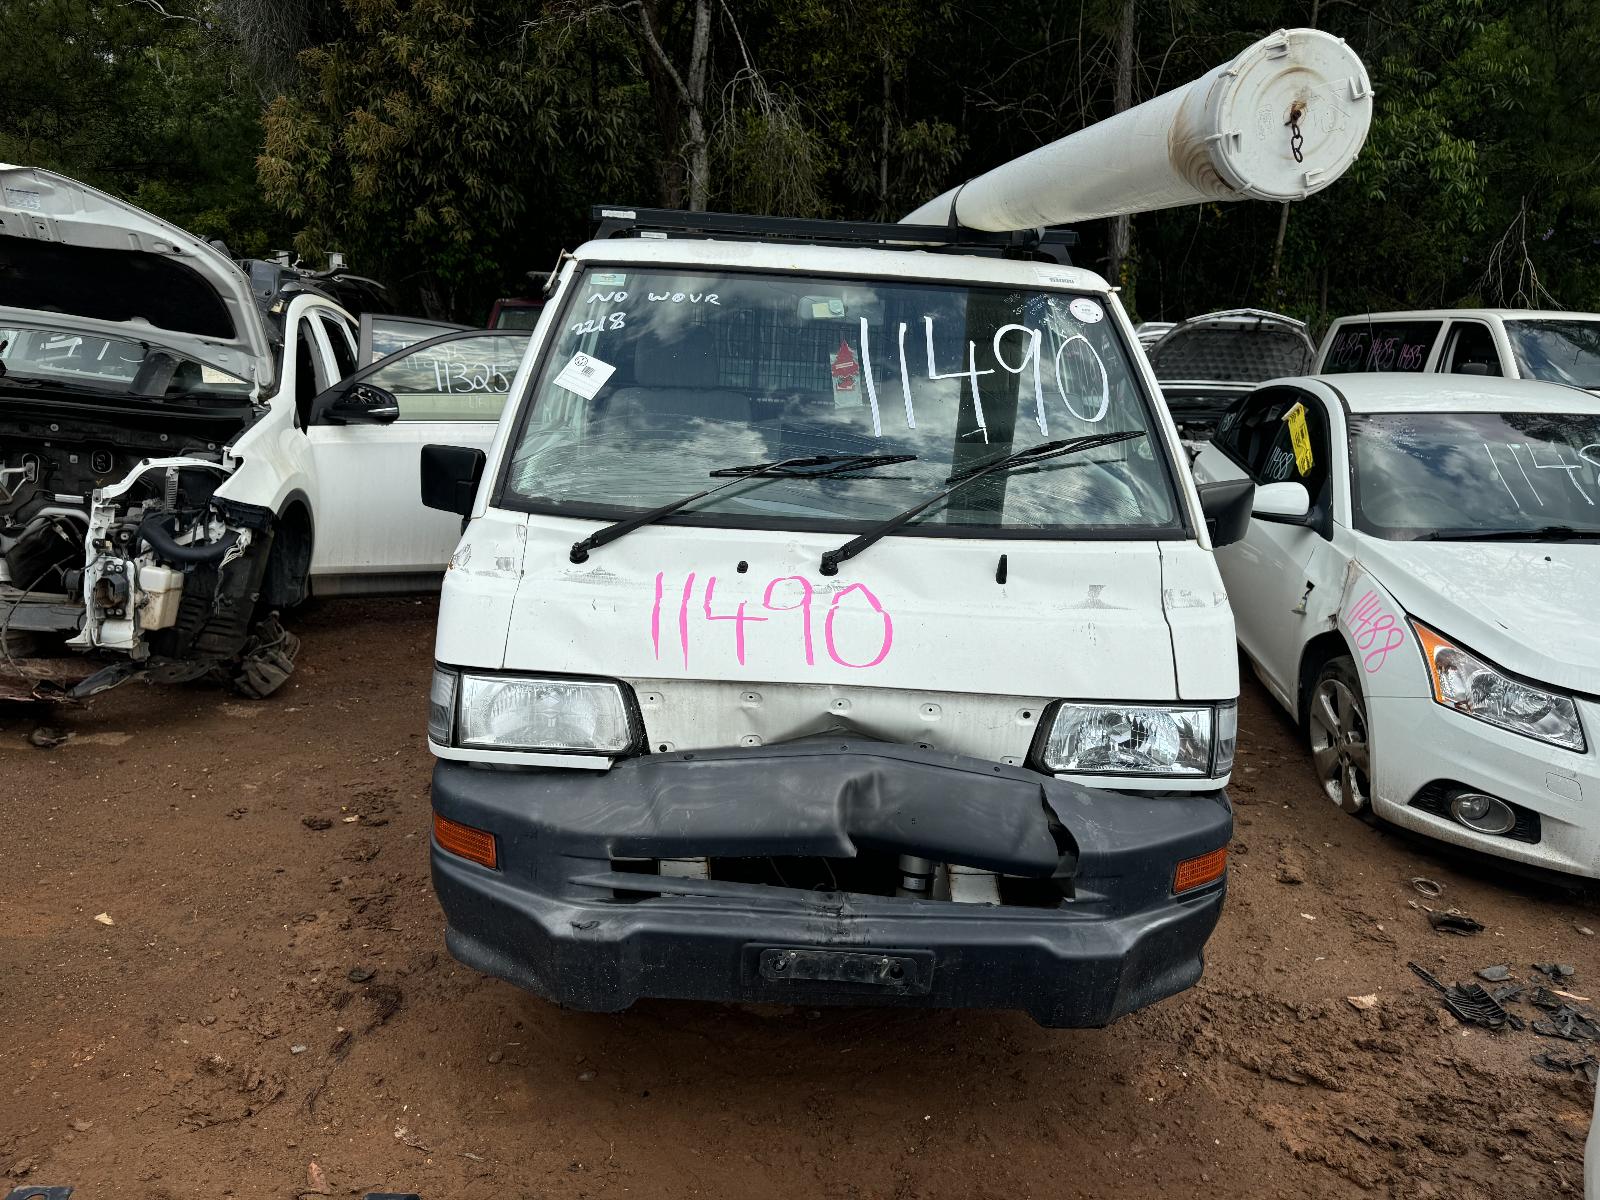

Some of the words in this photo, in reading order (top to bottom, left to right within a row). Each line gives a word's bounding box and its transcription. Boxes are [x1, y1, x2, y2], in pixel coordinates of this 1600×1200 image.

[587, 291, 629, 304] NO
[432, 359, 511, 394] 11325
[860, 316, 1110, 445] 11490
[1264, 446, 1294, 480] 11488
[651, 571, 893, 671] 11490
[1346, 590, 1405, 674] 11488
